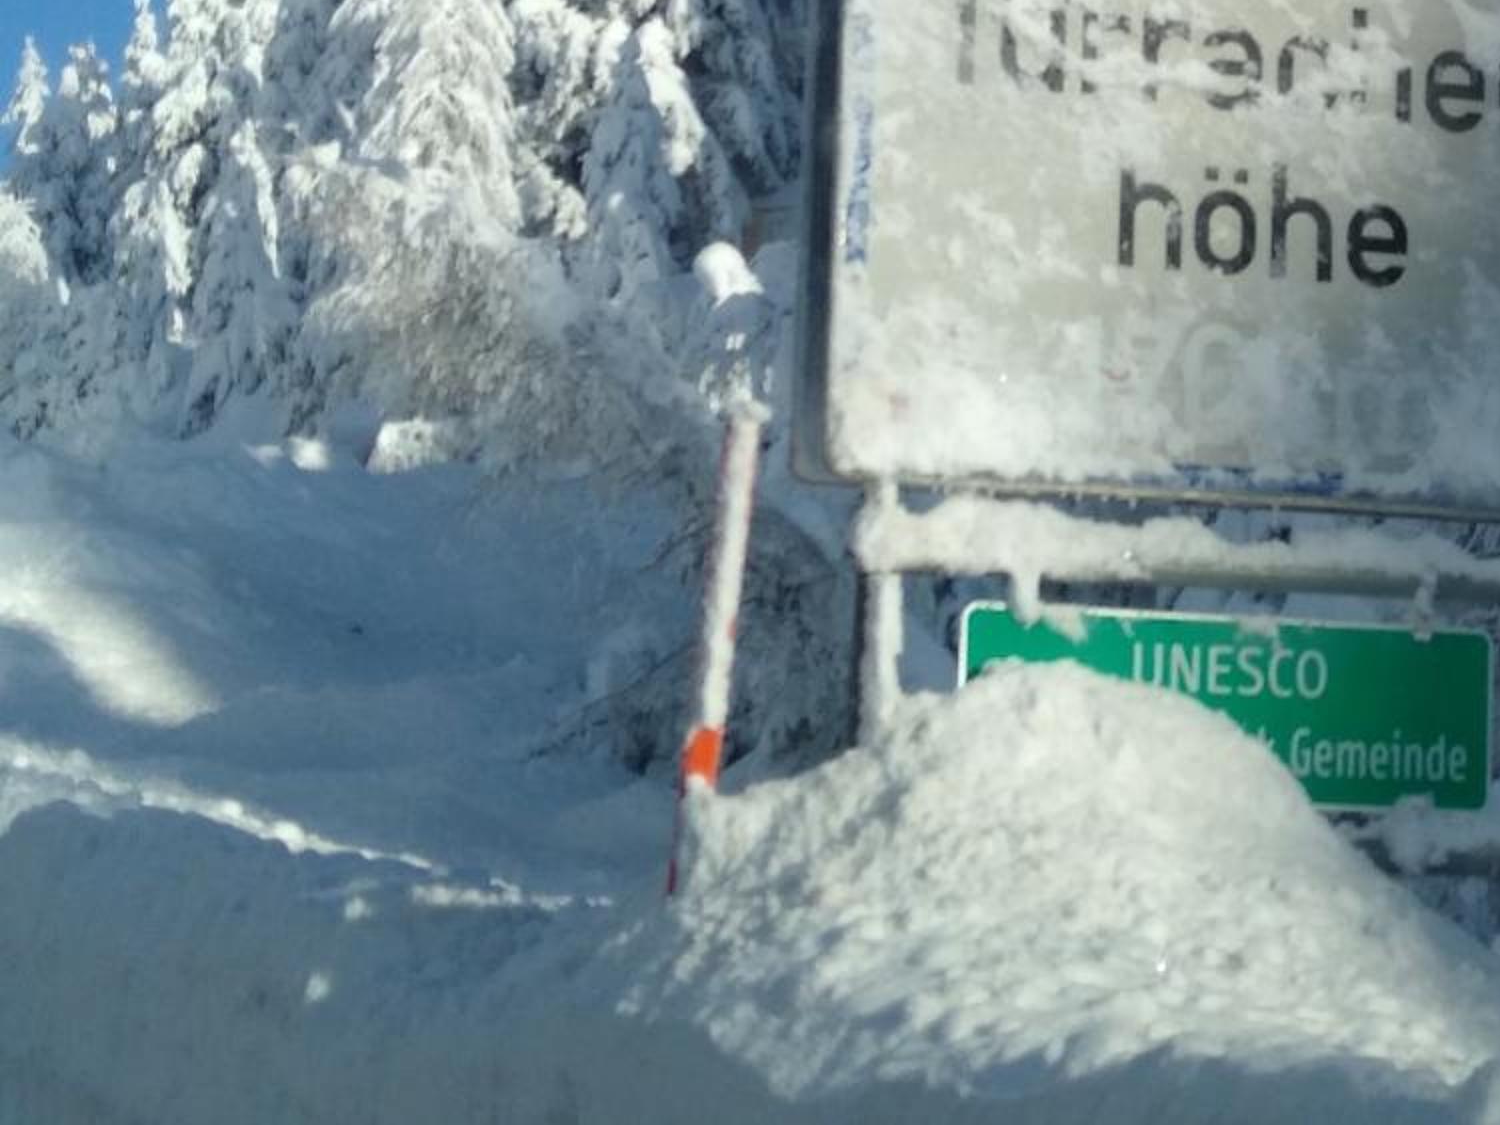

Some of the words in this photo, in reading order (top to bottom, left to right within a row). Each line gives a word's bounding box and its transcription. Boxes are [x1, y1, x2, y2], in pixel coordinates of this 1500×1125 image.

[1118, 163, 1408, 287] höhe
[1133, 641, 1329, 699] UNESCO
[1290, 726, 1468, 782] Gemeinde
